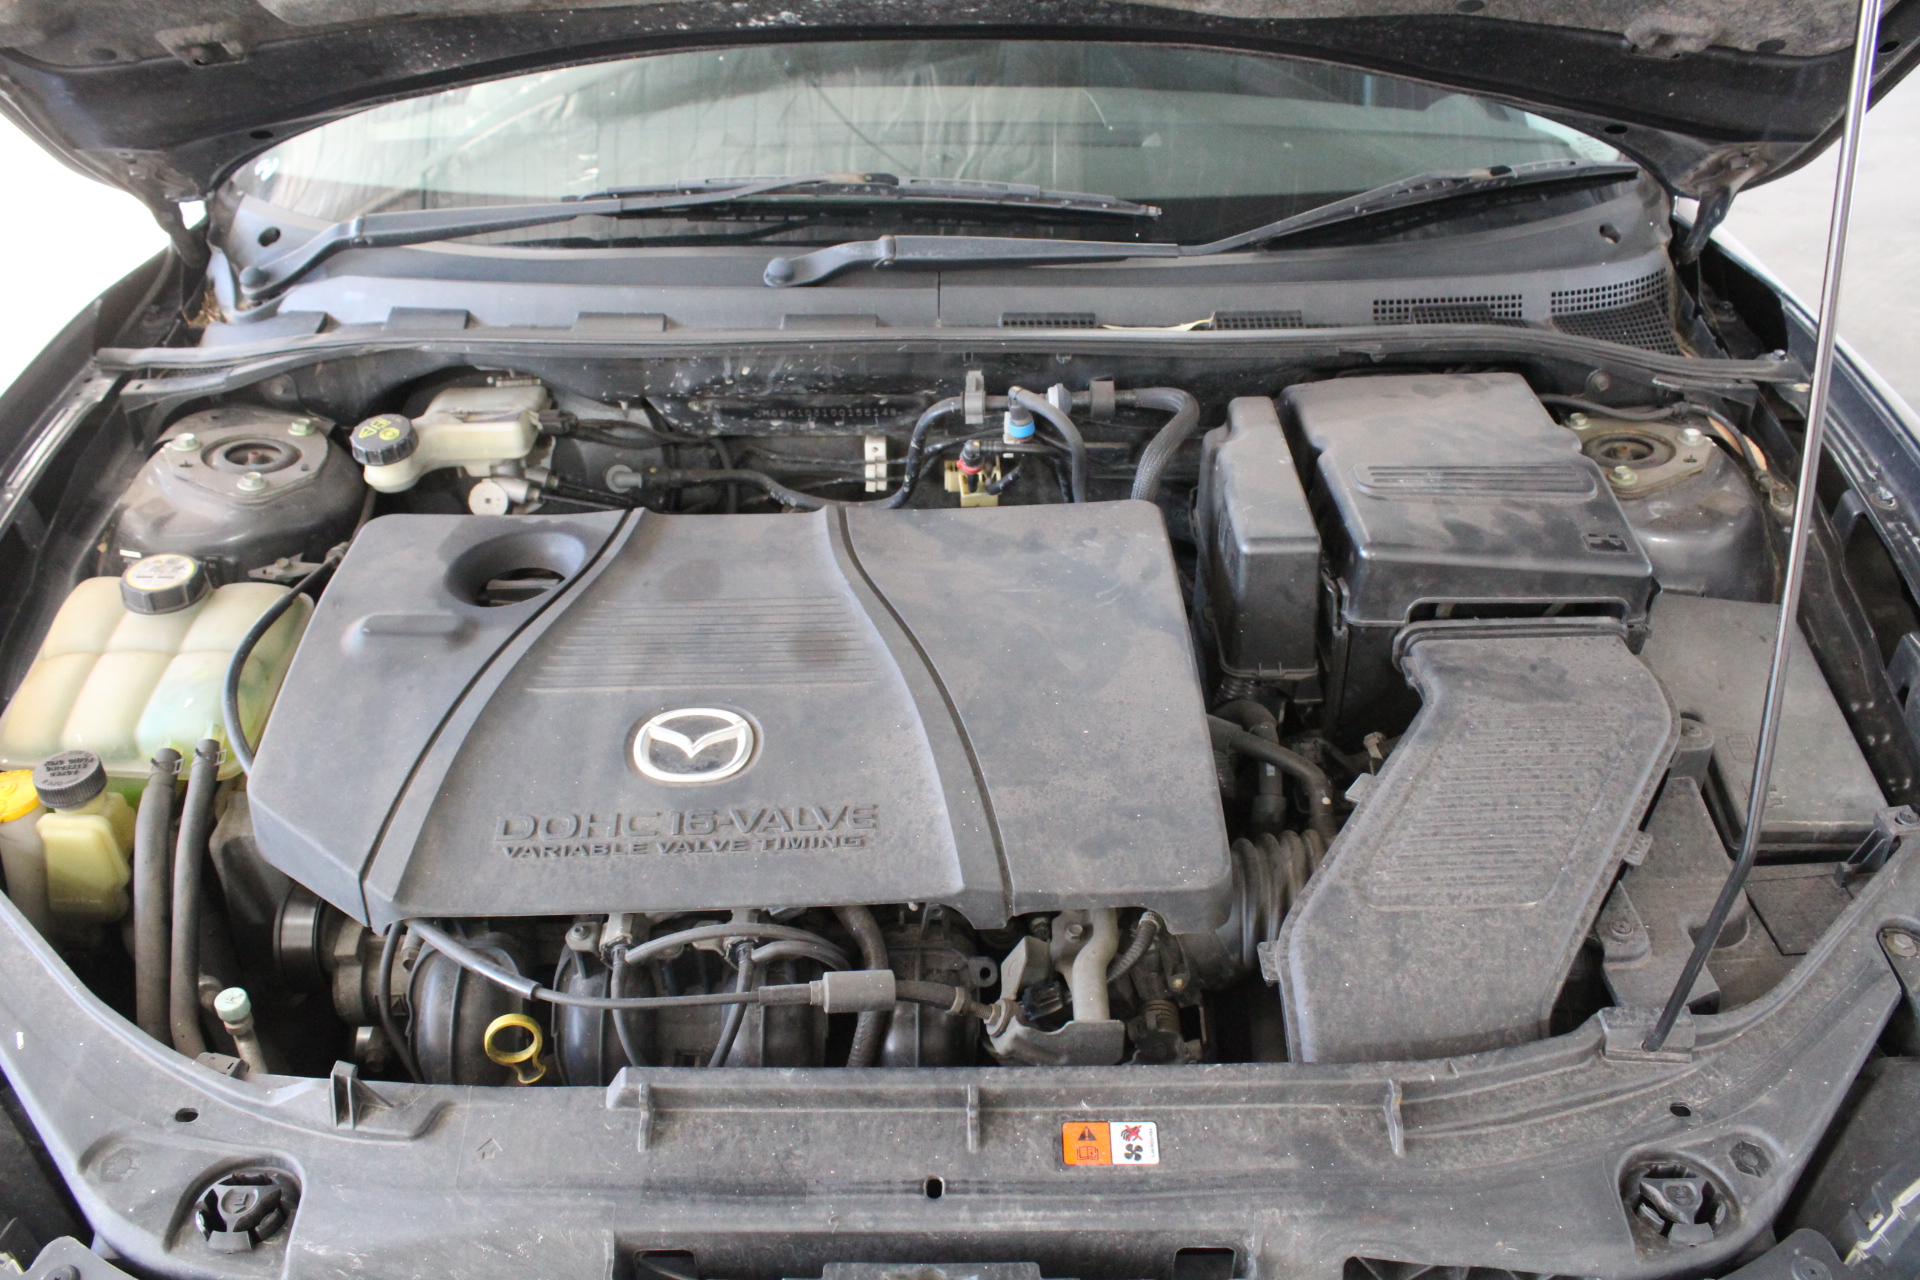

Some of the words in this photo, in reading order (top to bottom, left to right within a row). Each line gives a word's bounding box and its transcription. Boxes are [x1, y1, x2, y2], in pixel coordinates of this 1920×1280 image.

[495, 811, 661, 843] DOHC
[670, 804, 880, 836] 16-VALVE
[503, 842, 649, 859] VARIABLE
[655, 839, 750, 855] VALVE
[757, 834, 866, 852] TIMING
